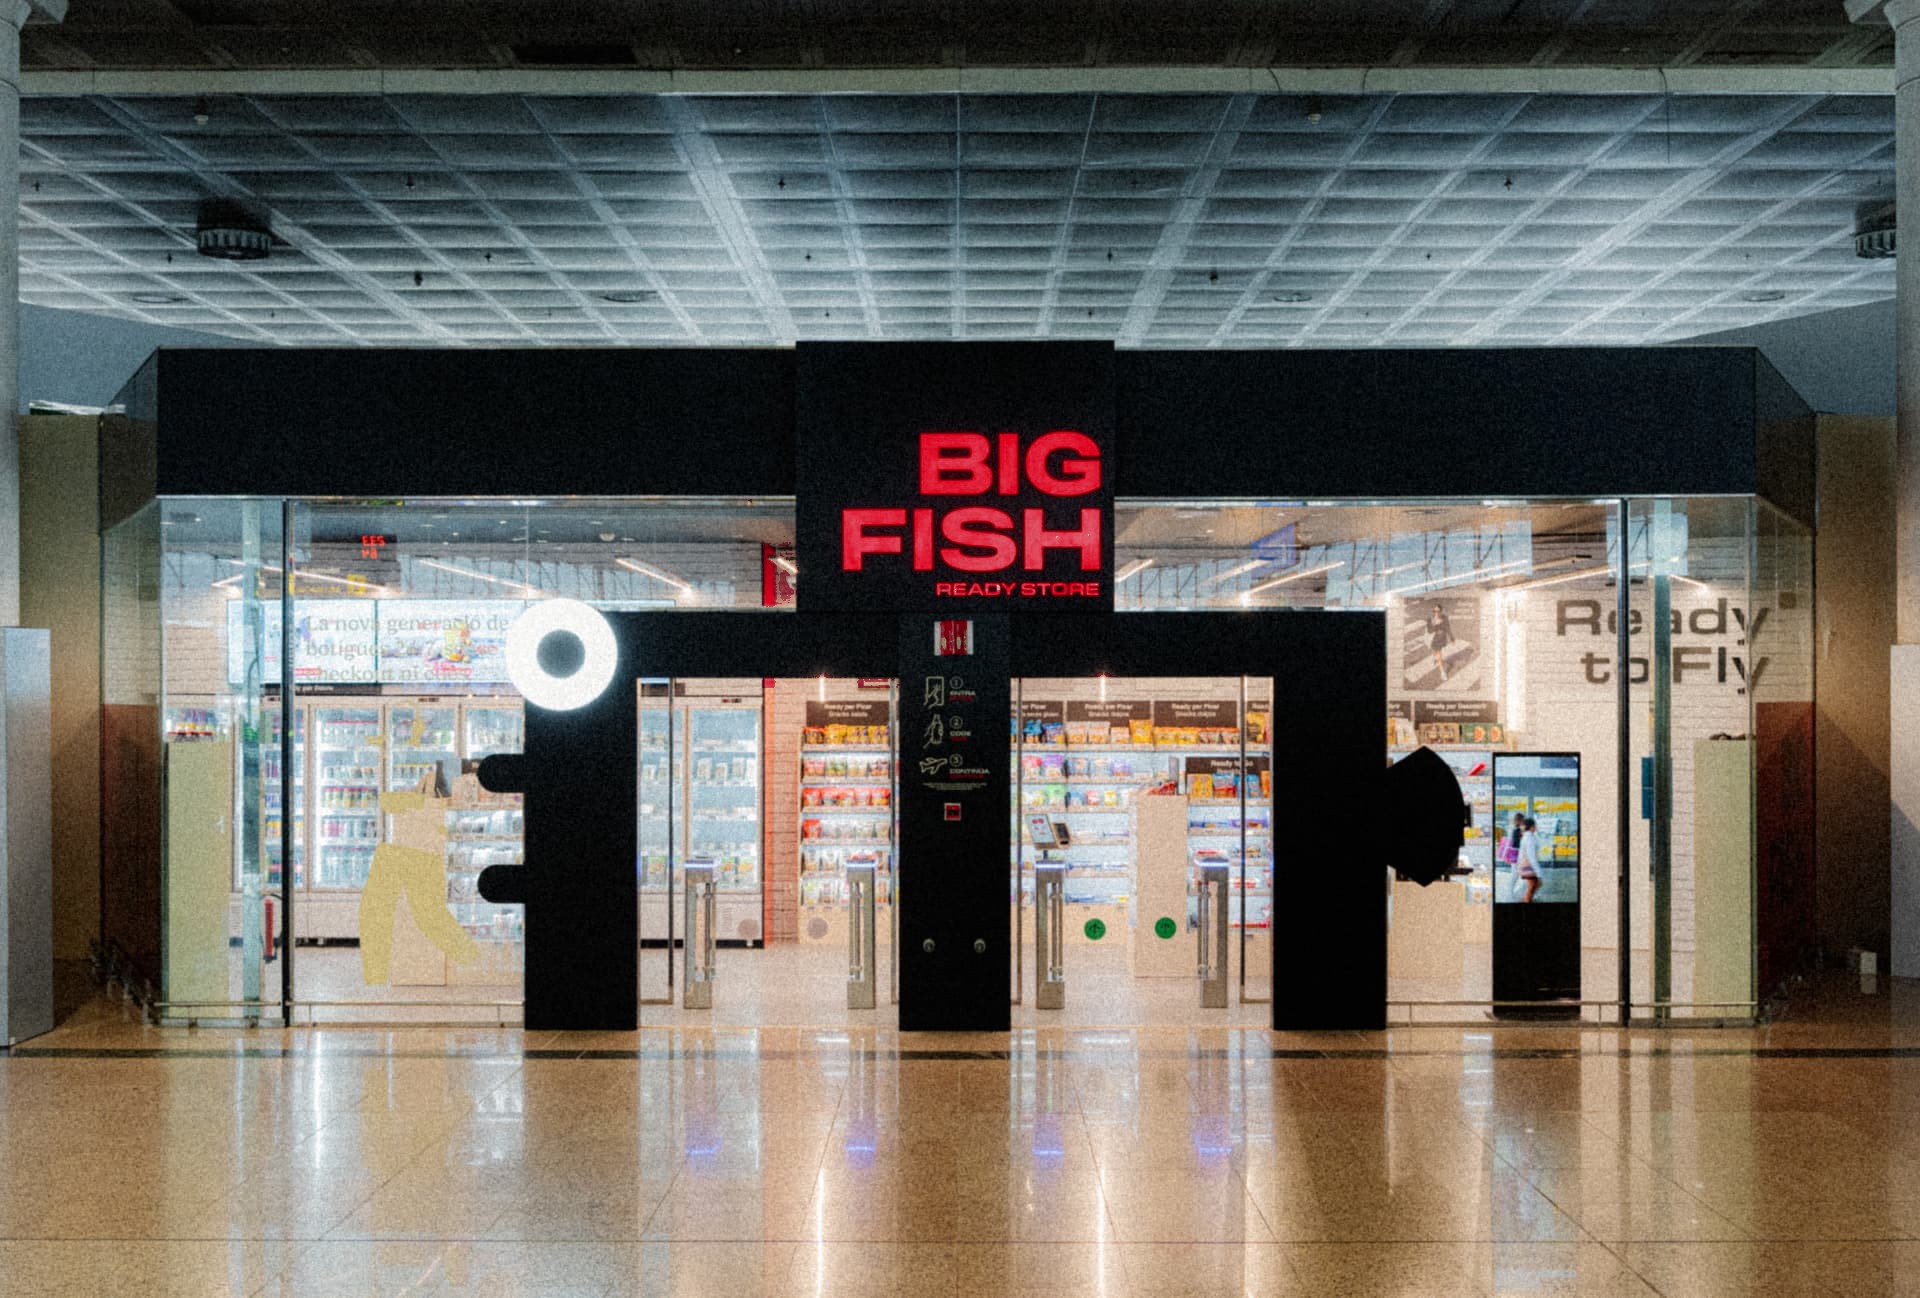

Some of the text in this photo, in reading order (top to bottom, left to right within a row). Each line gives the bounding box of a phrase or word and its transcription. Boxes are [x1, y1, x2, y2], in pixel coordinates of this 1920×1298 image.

[919, 431, 1101, 497] BIG
[842, 506, 1101, 573] FISH
[936, 582, 1100, 597] READY STORE
[486, 613, 509, 632] de
[1556, 597, 1770, 645] Ready
[1672, 646, 1770, 695] Fly
